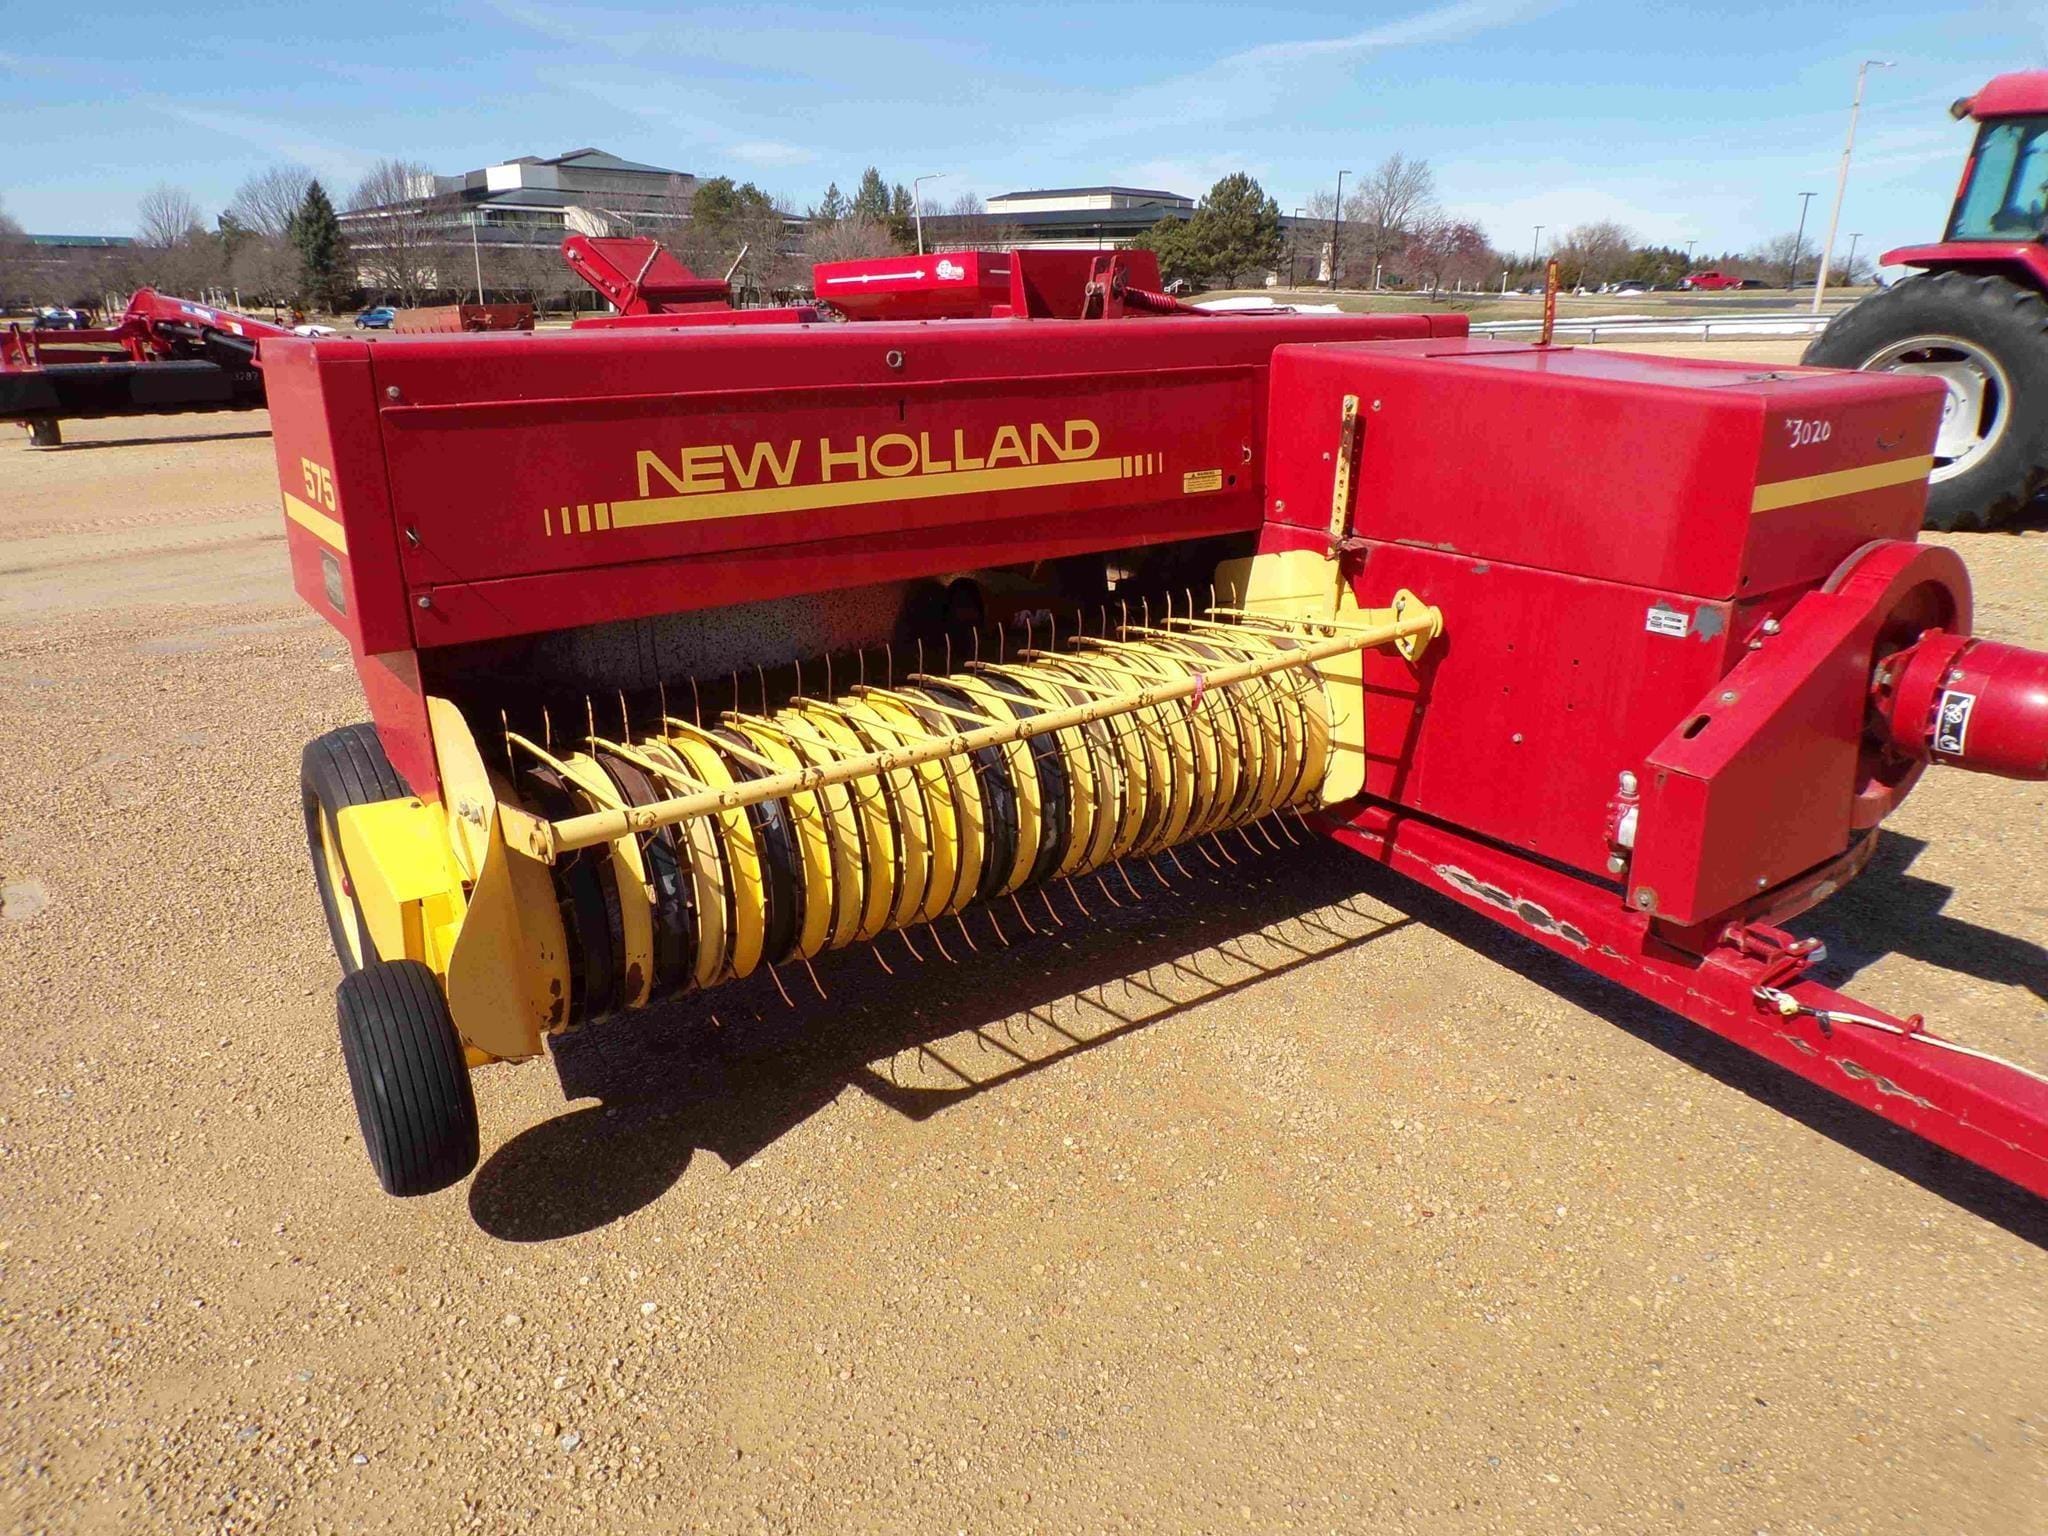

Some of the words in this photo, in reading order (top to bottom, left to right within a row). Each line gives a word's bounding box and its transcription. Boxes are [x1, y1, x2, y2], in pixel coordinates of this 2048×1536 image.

[301, 457, 336, 512] 575
[636, 440, 801, 496] NEW
[820, 419, 1100, 482] HOLLAND
